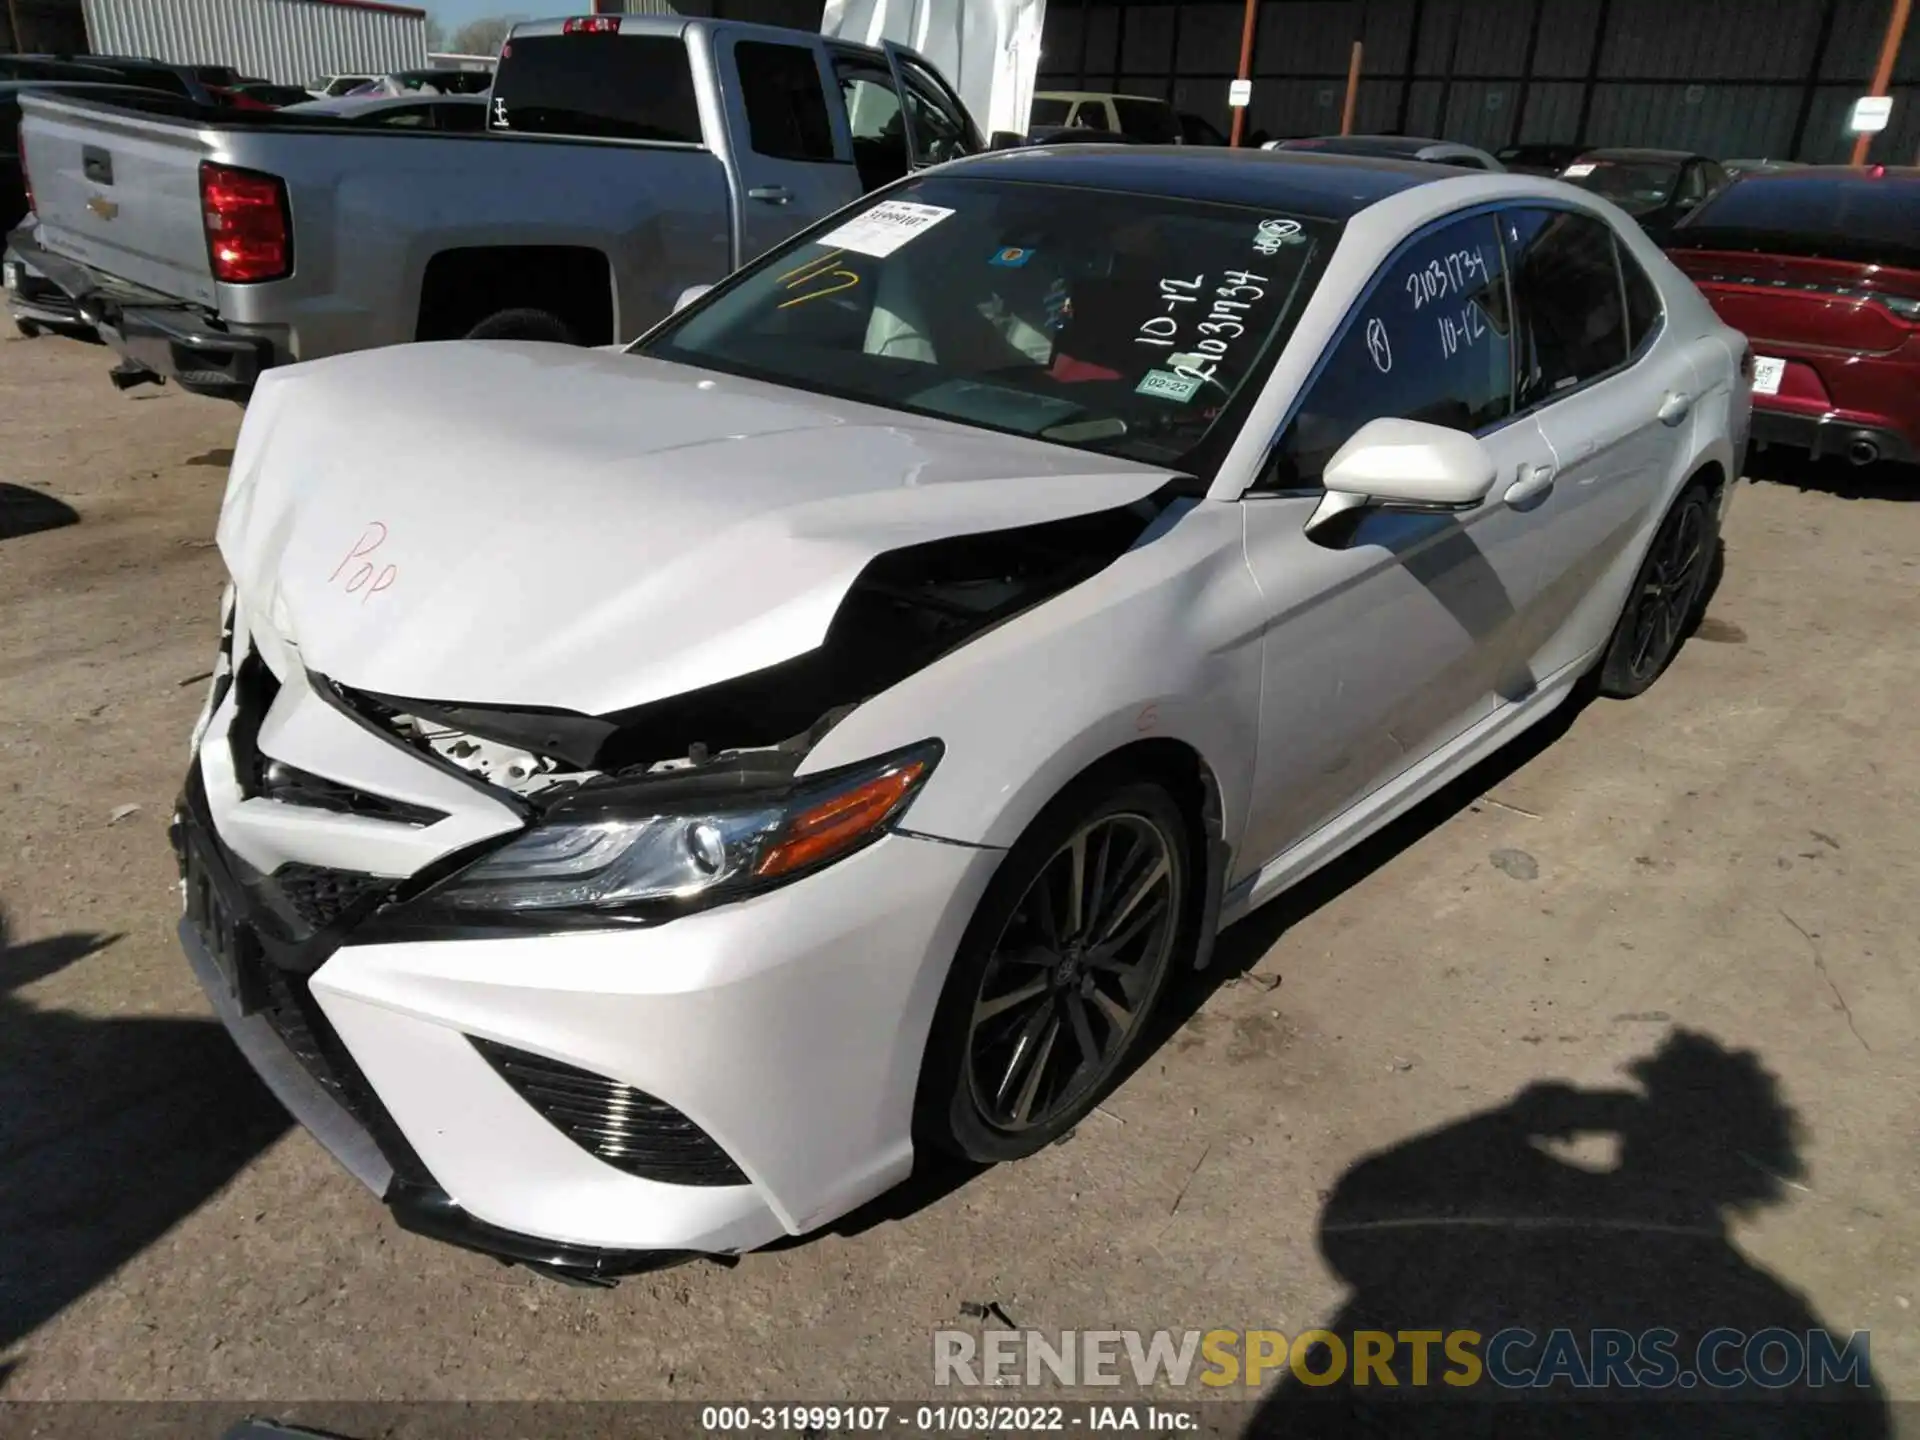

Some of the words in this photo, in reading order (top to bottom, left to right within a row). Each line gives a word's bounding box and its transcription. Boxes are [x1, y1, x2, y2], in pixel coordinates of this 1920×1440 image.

[1135, 274, 1204, 345] 10-12
[1406, 245, 1490, 310] 21031734
[1174, 270, 1269, 382] 21031734
[1437, 299, 1486, 360] 10-12
